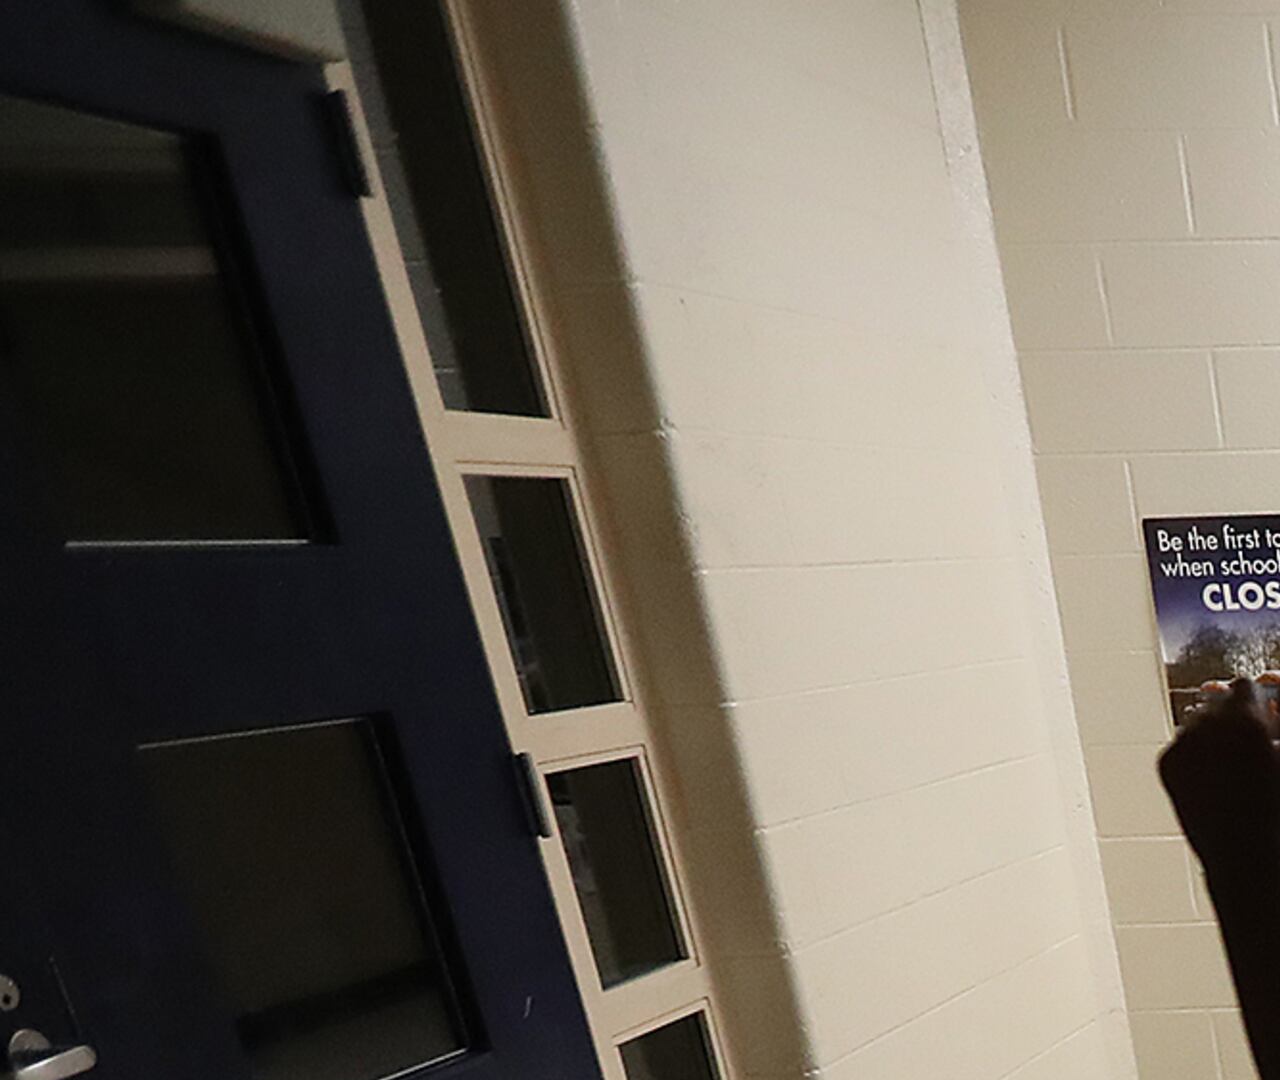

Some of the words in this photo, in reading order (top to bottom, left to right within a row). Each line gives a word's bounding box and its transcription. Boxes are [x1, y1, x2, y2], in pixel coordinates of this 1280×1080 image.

[1157, 529, 1183, 552] Be
[1188, 526, 1218, 550] the
[1223, 524, 1260, 549] first
[1160, 552, 1215, 577] when
